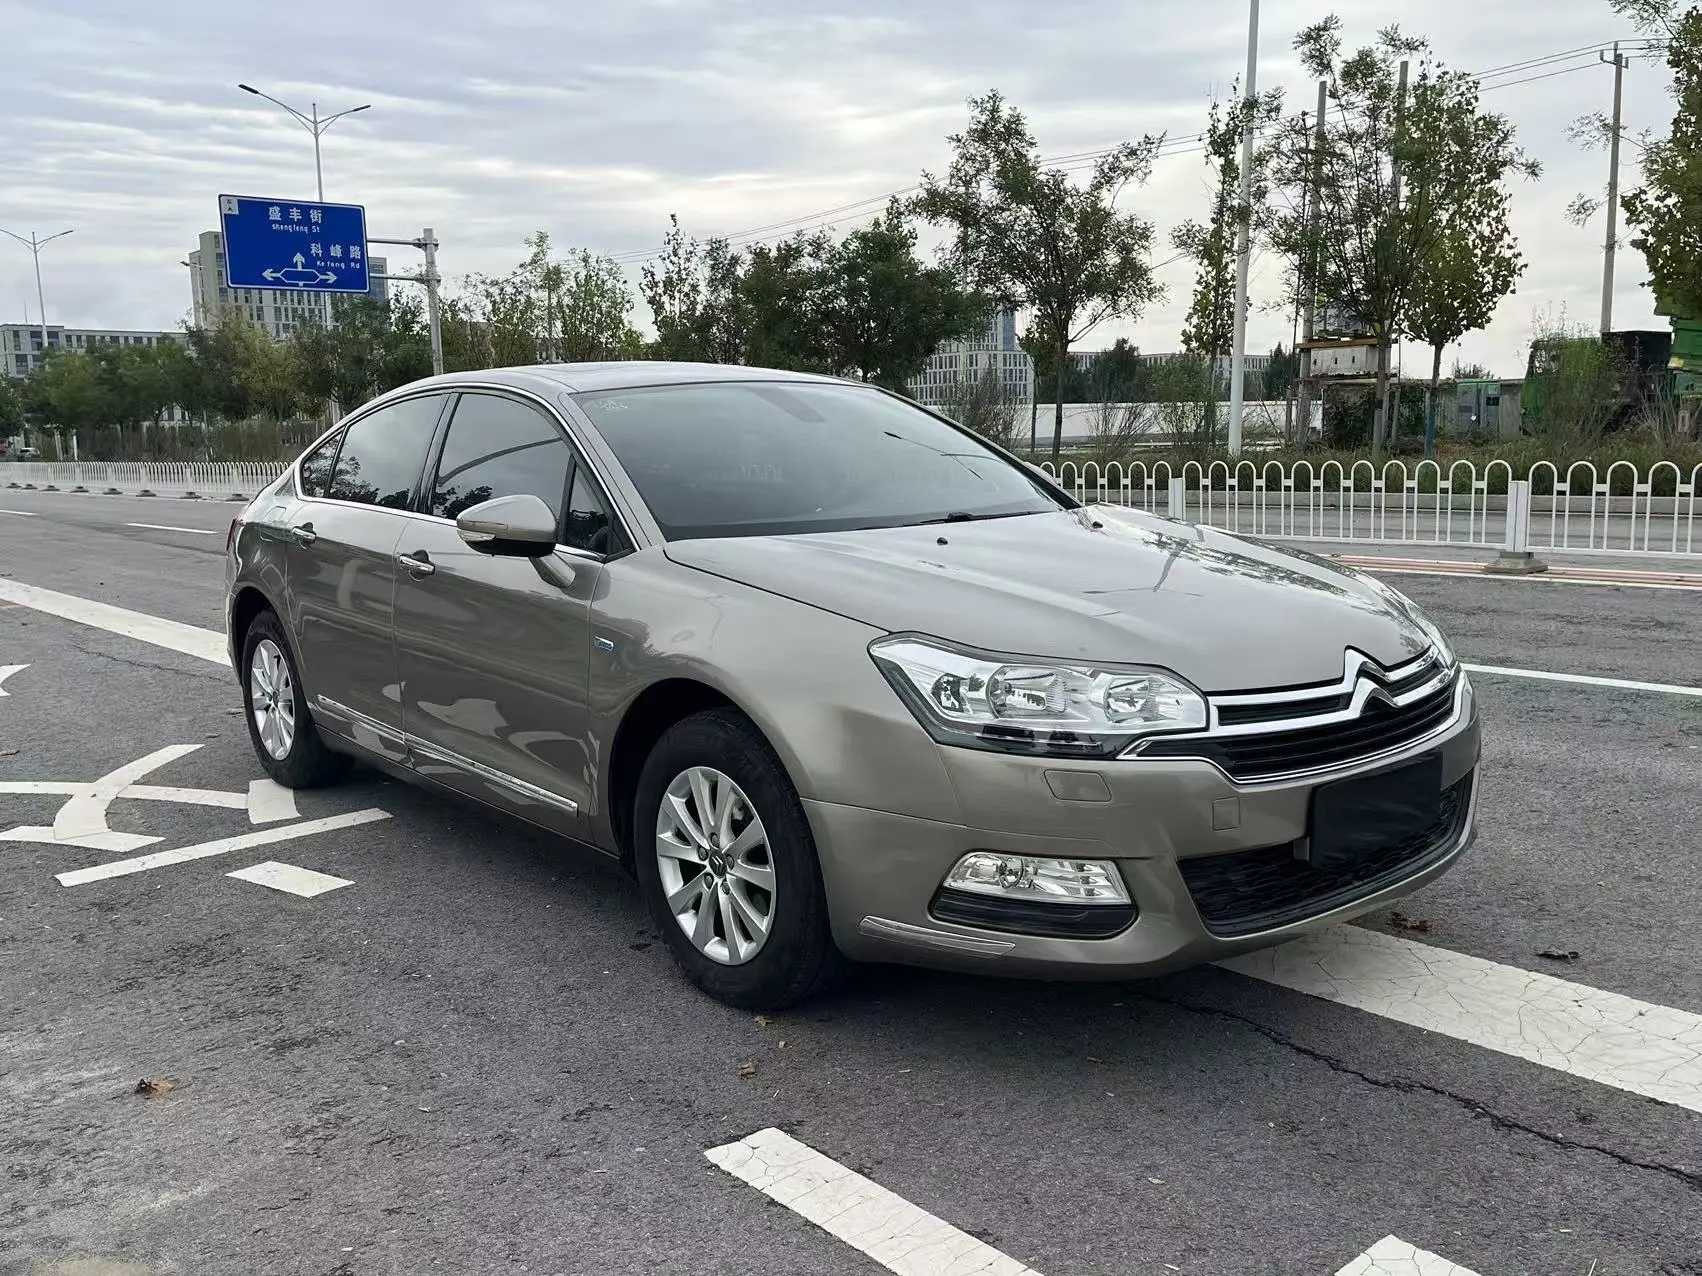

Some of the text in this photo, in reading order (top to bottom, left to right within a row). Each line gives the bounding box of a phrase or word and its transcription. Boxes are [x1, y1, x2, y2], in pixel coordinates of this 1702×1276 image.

[268, 206, 322, 223] 盛丰街
[310, 243, 361, 259] 科峰路
